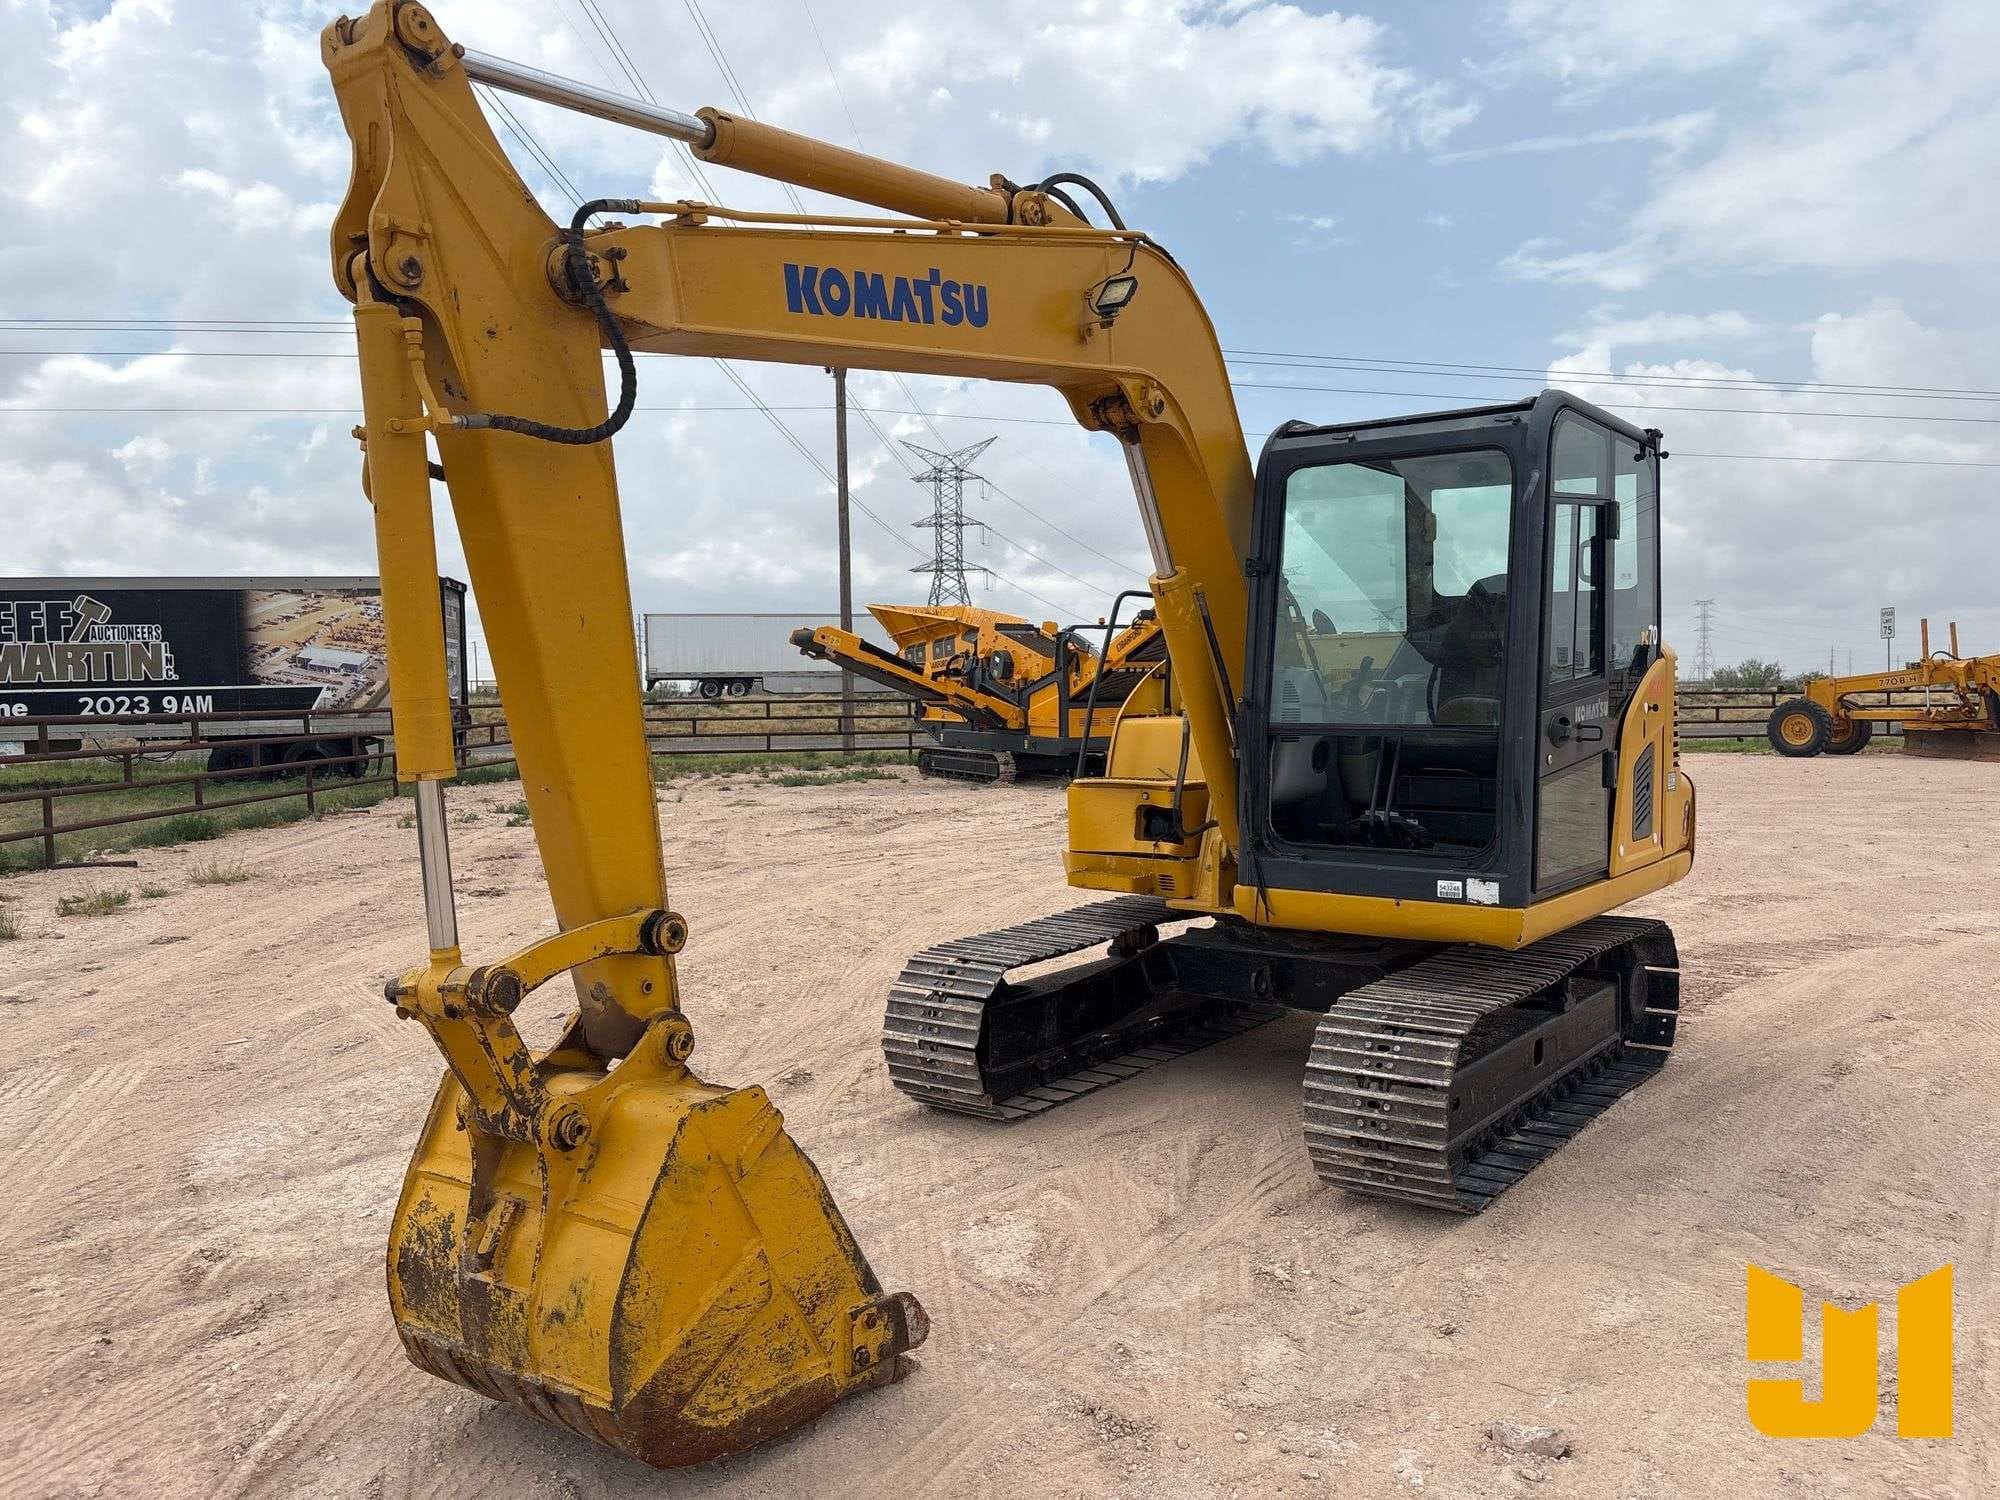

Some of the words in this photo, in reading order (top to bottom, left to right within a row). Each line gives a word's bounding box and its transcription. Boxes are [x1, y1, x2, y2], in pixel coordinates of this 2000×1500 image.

[783, 262, 989, 328] KOMATSU
[90, 625, 161, 641] AUCTIONEERS
[1883, 626, 1892, 635] 75
[78, 695, 150, 715] 2023
[1575, 698, 1608, 722] KOMATSU
